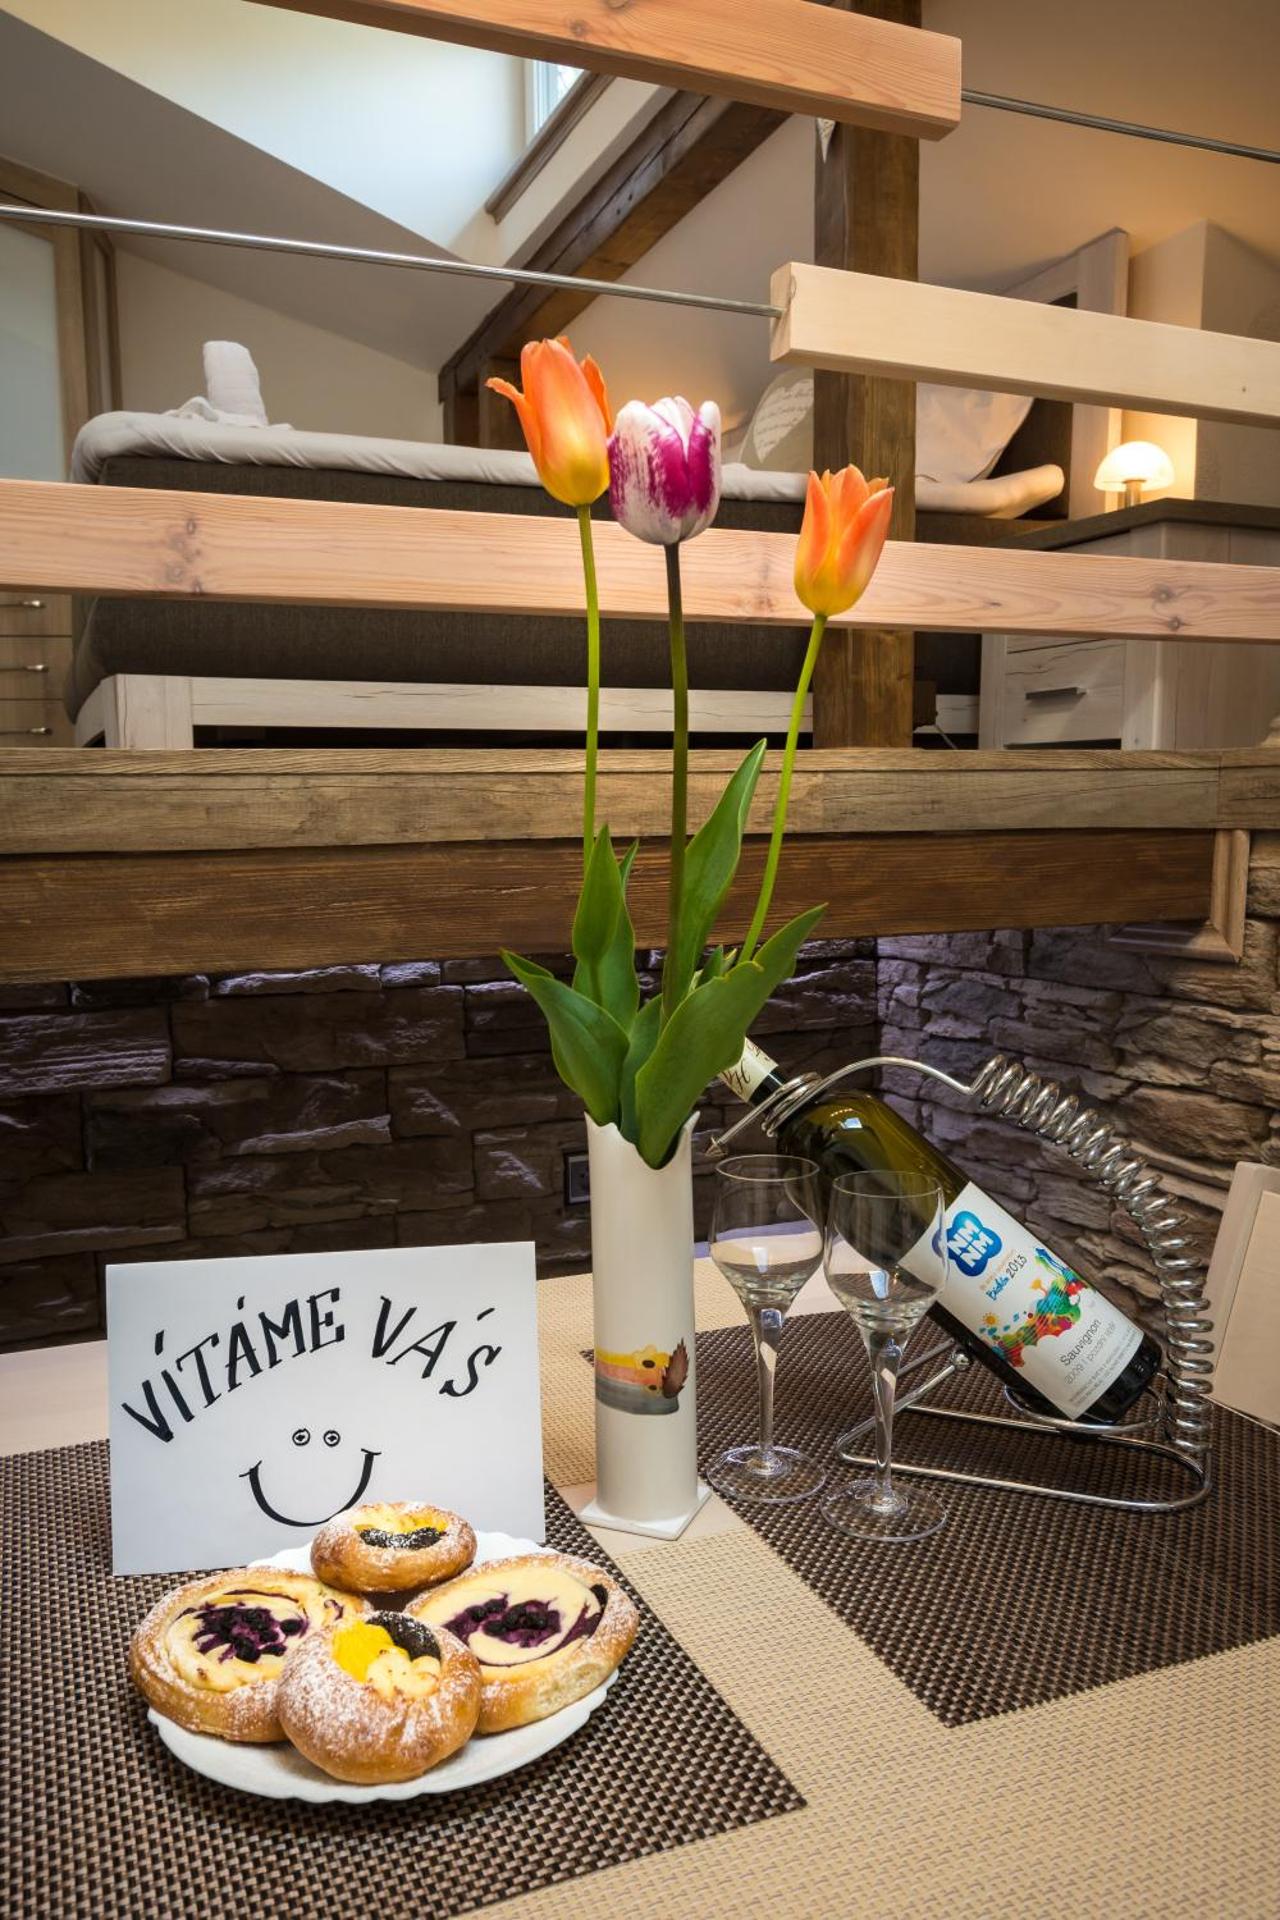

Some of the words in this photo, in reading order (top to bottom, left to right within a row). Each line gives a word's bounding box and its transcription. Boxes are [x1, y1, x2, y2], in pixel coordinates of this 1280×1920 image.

[1006, 1254, 1028, 1278] 2013
[122, 1287, 344, 1443] VÍTÁME
[1061, 1319, 1102, 1367] Sauvignon
